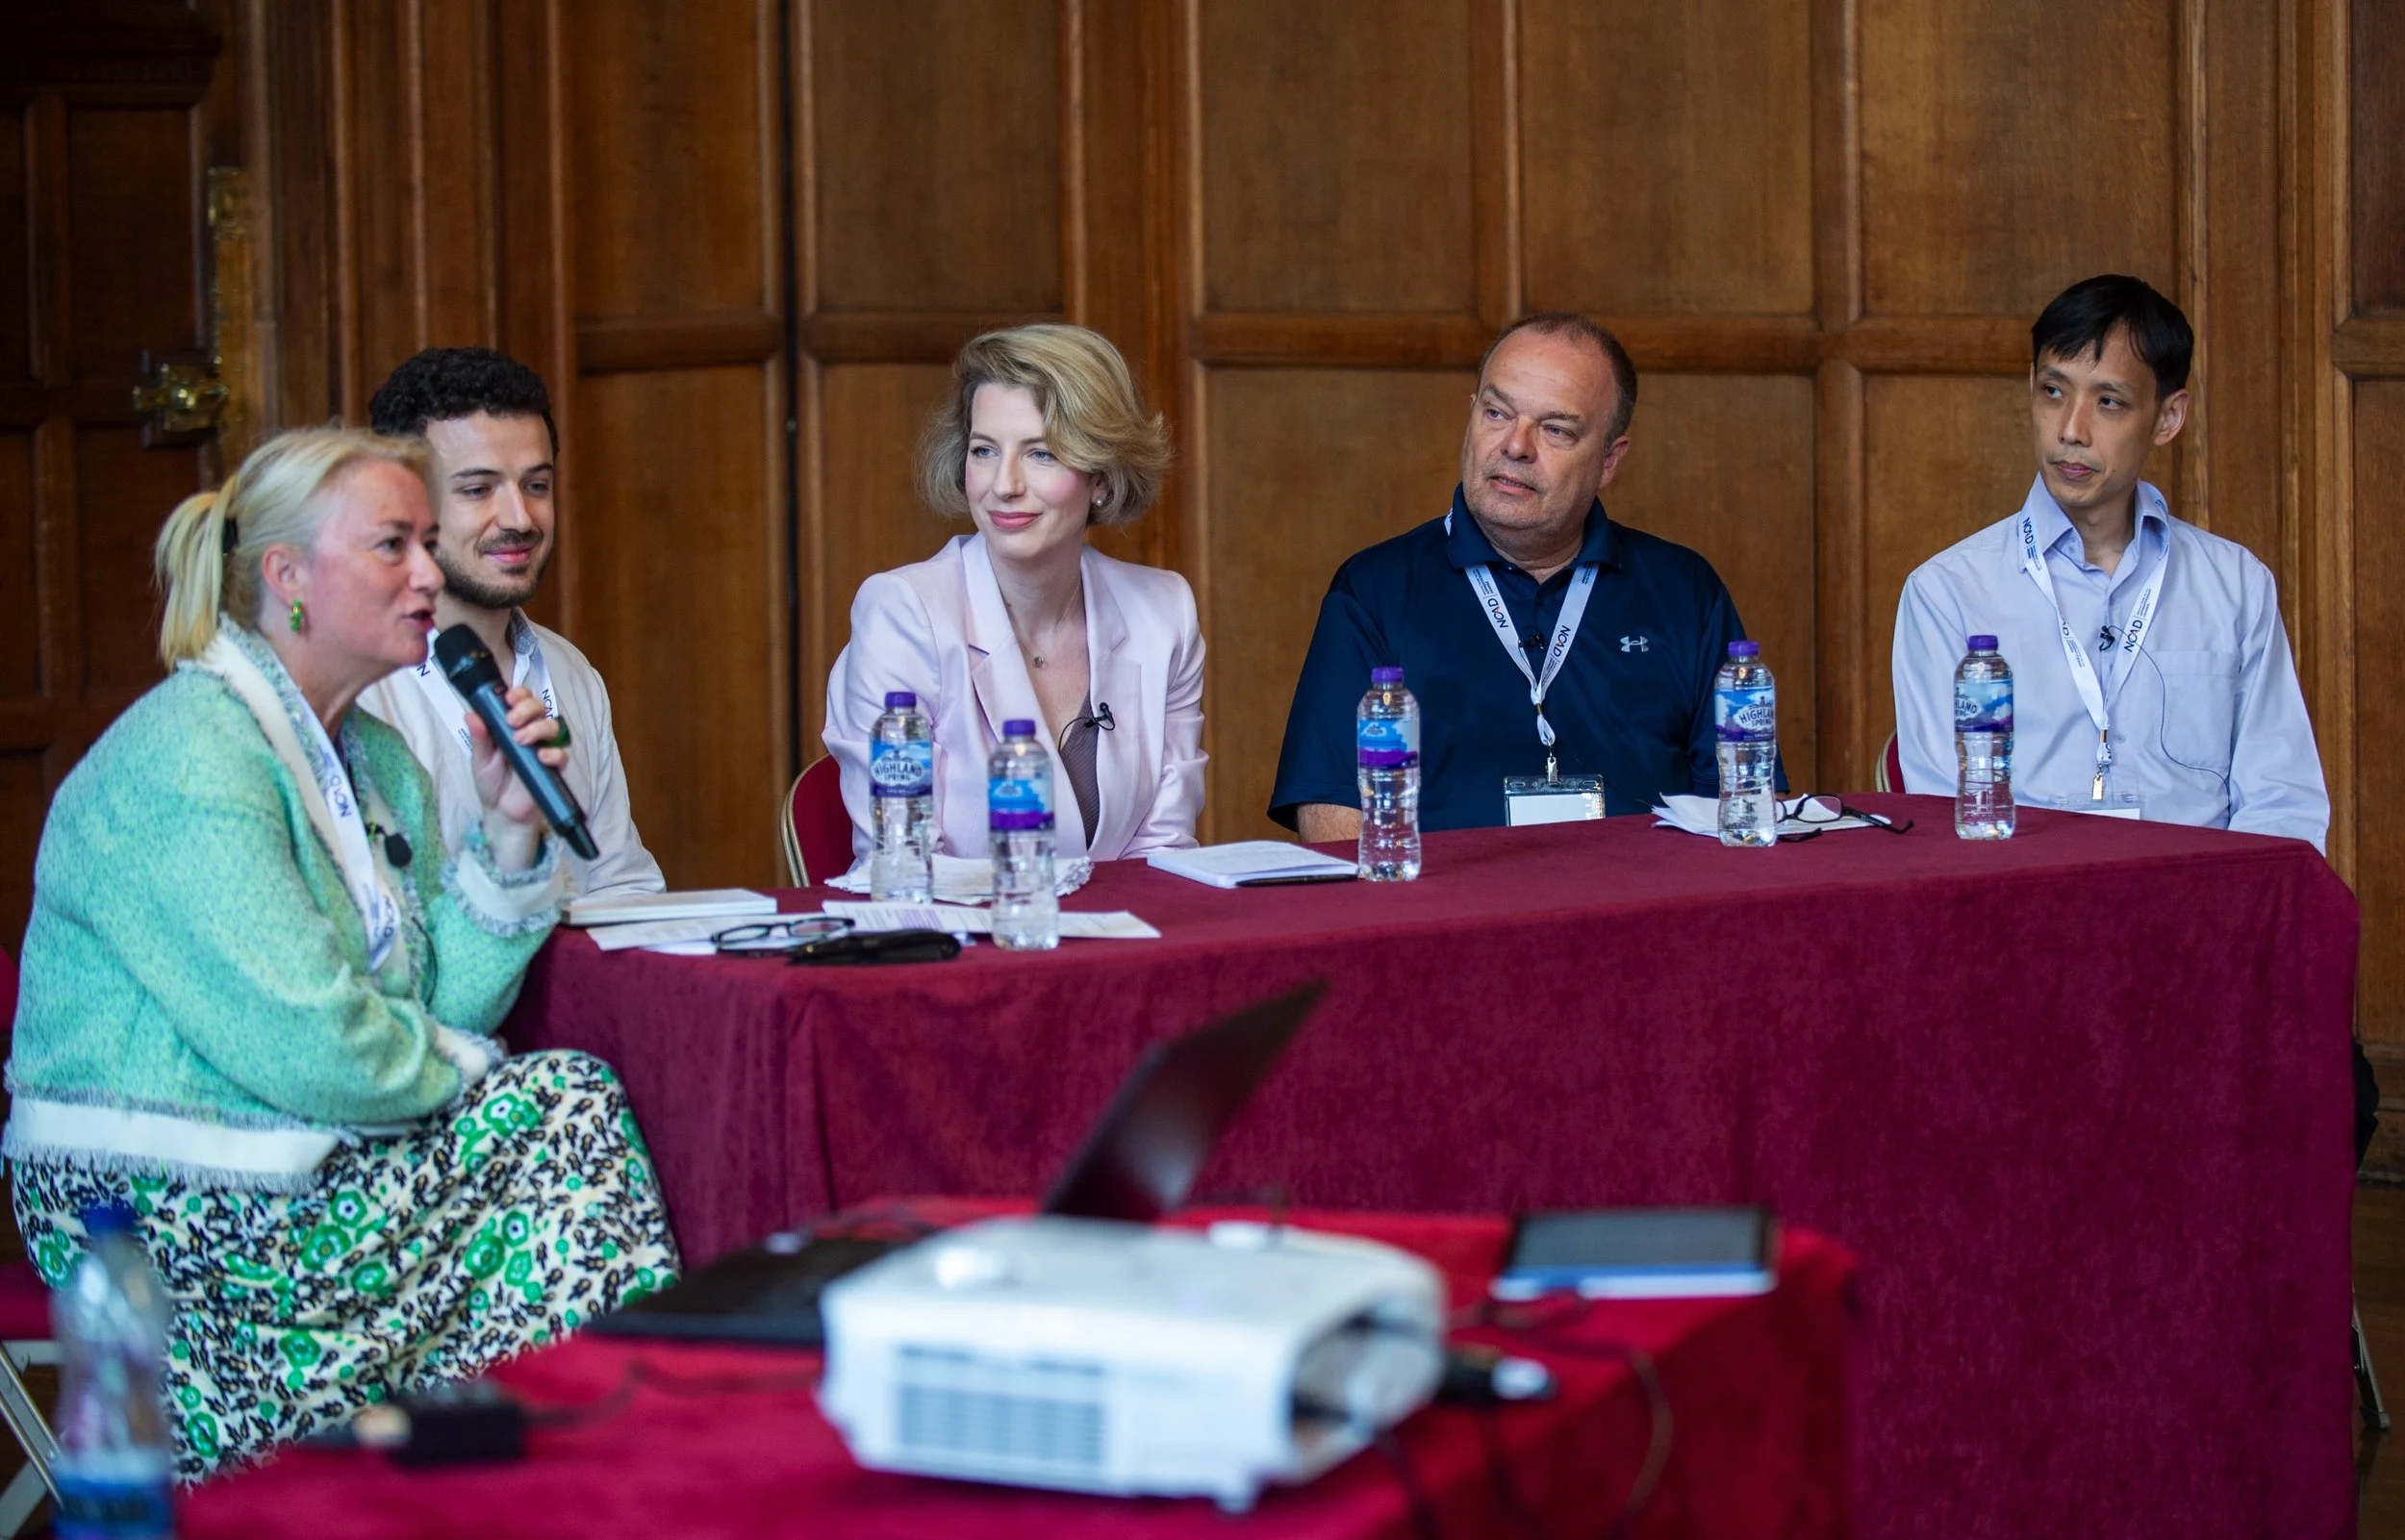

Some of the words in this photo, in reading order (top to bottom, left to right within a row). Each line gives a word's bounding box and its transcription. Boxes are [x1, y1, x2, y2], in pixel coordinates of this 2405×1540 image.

[2022, 517, 2035, 544] NCAD
[1487, 597, 1509, 628] NCAD
[1553, 624, 1572, 657] NCAD
[2124, 619, 2143, 653] NCAD
[874, 763, 923, 777] HIGHLAND
